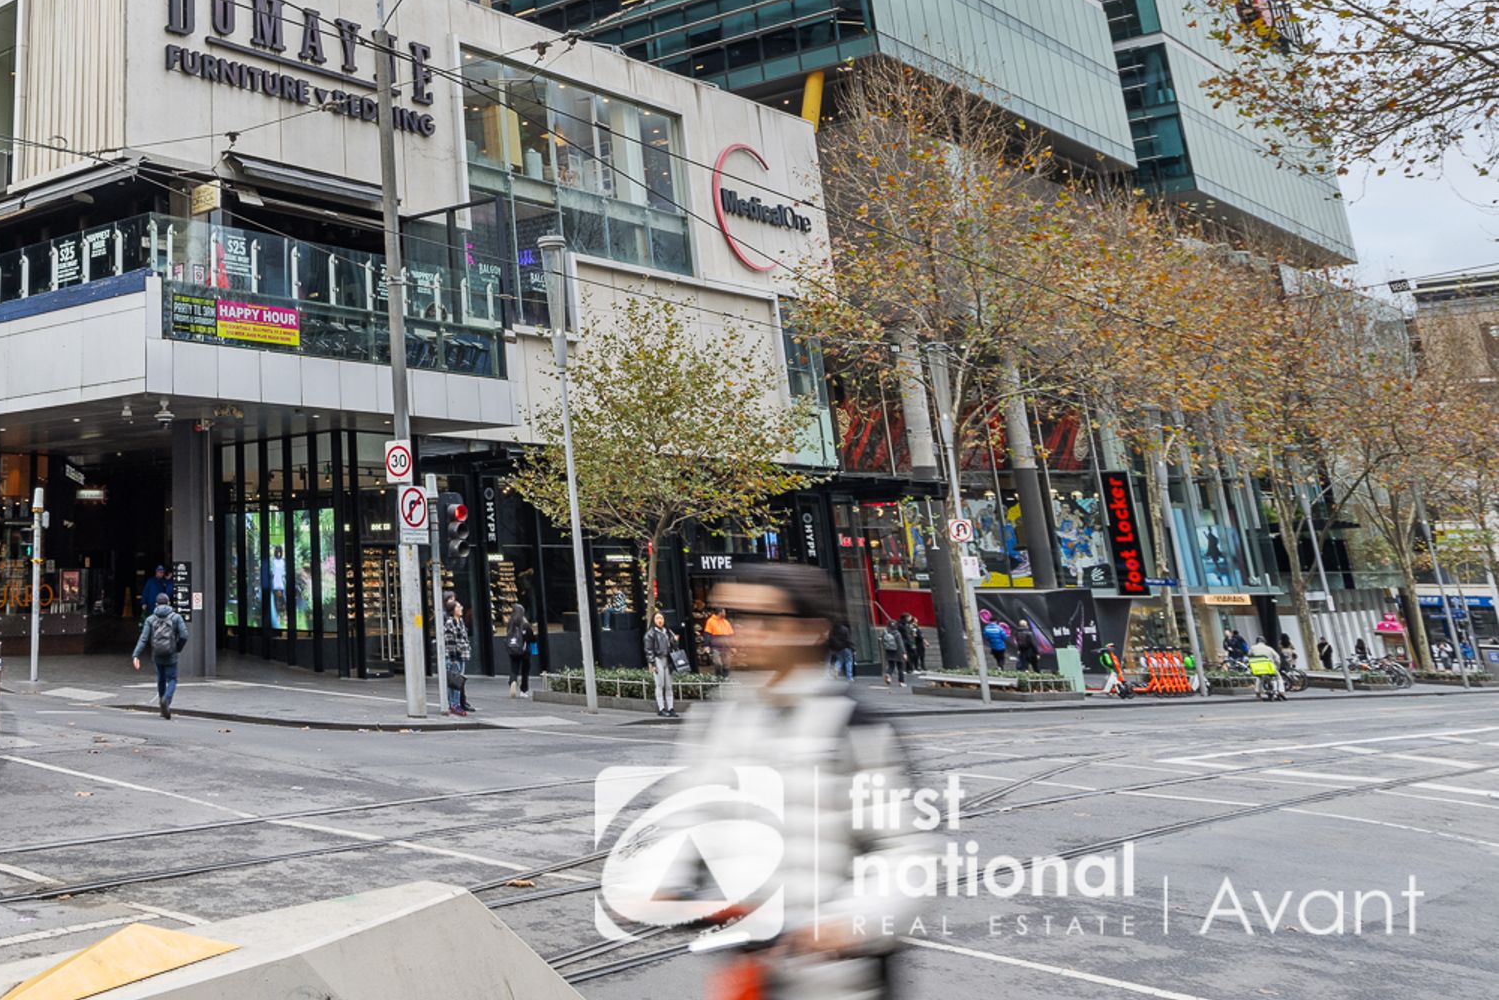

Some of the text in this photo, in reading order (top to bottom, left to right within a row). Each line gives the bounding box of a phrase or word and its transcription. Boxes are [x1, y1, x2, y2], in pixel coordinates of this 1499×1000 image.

[165, 43, 436, 138] FURNITURE BEDING
[720, 187, 812, 234] MedicalOne
[226, 239, 247, 256] $25
[219, 304, 260, 321] HAPPY
[262, 310, 297, 326] HOUR
[390, 453, 407, 468] 30
[486, 501, 497, 543] HYPE
[1108, 477, 1145, 592] Foot Locker
[804, 524, 816, 558] HYPE
[701, 555, 733, 570] HYPE
